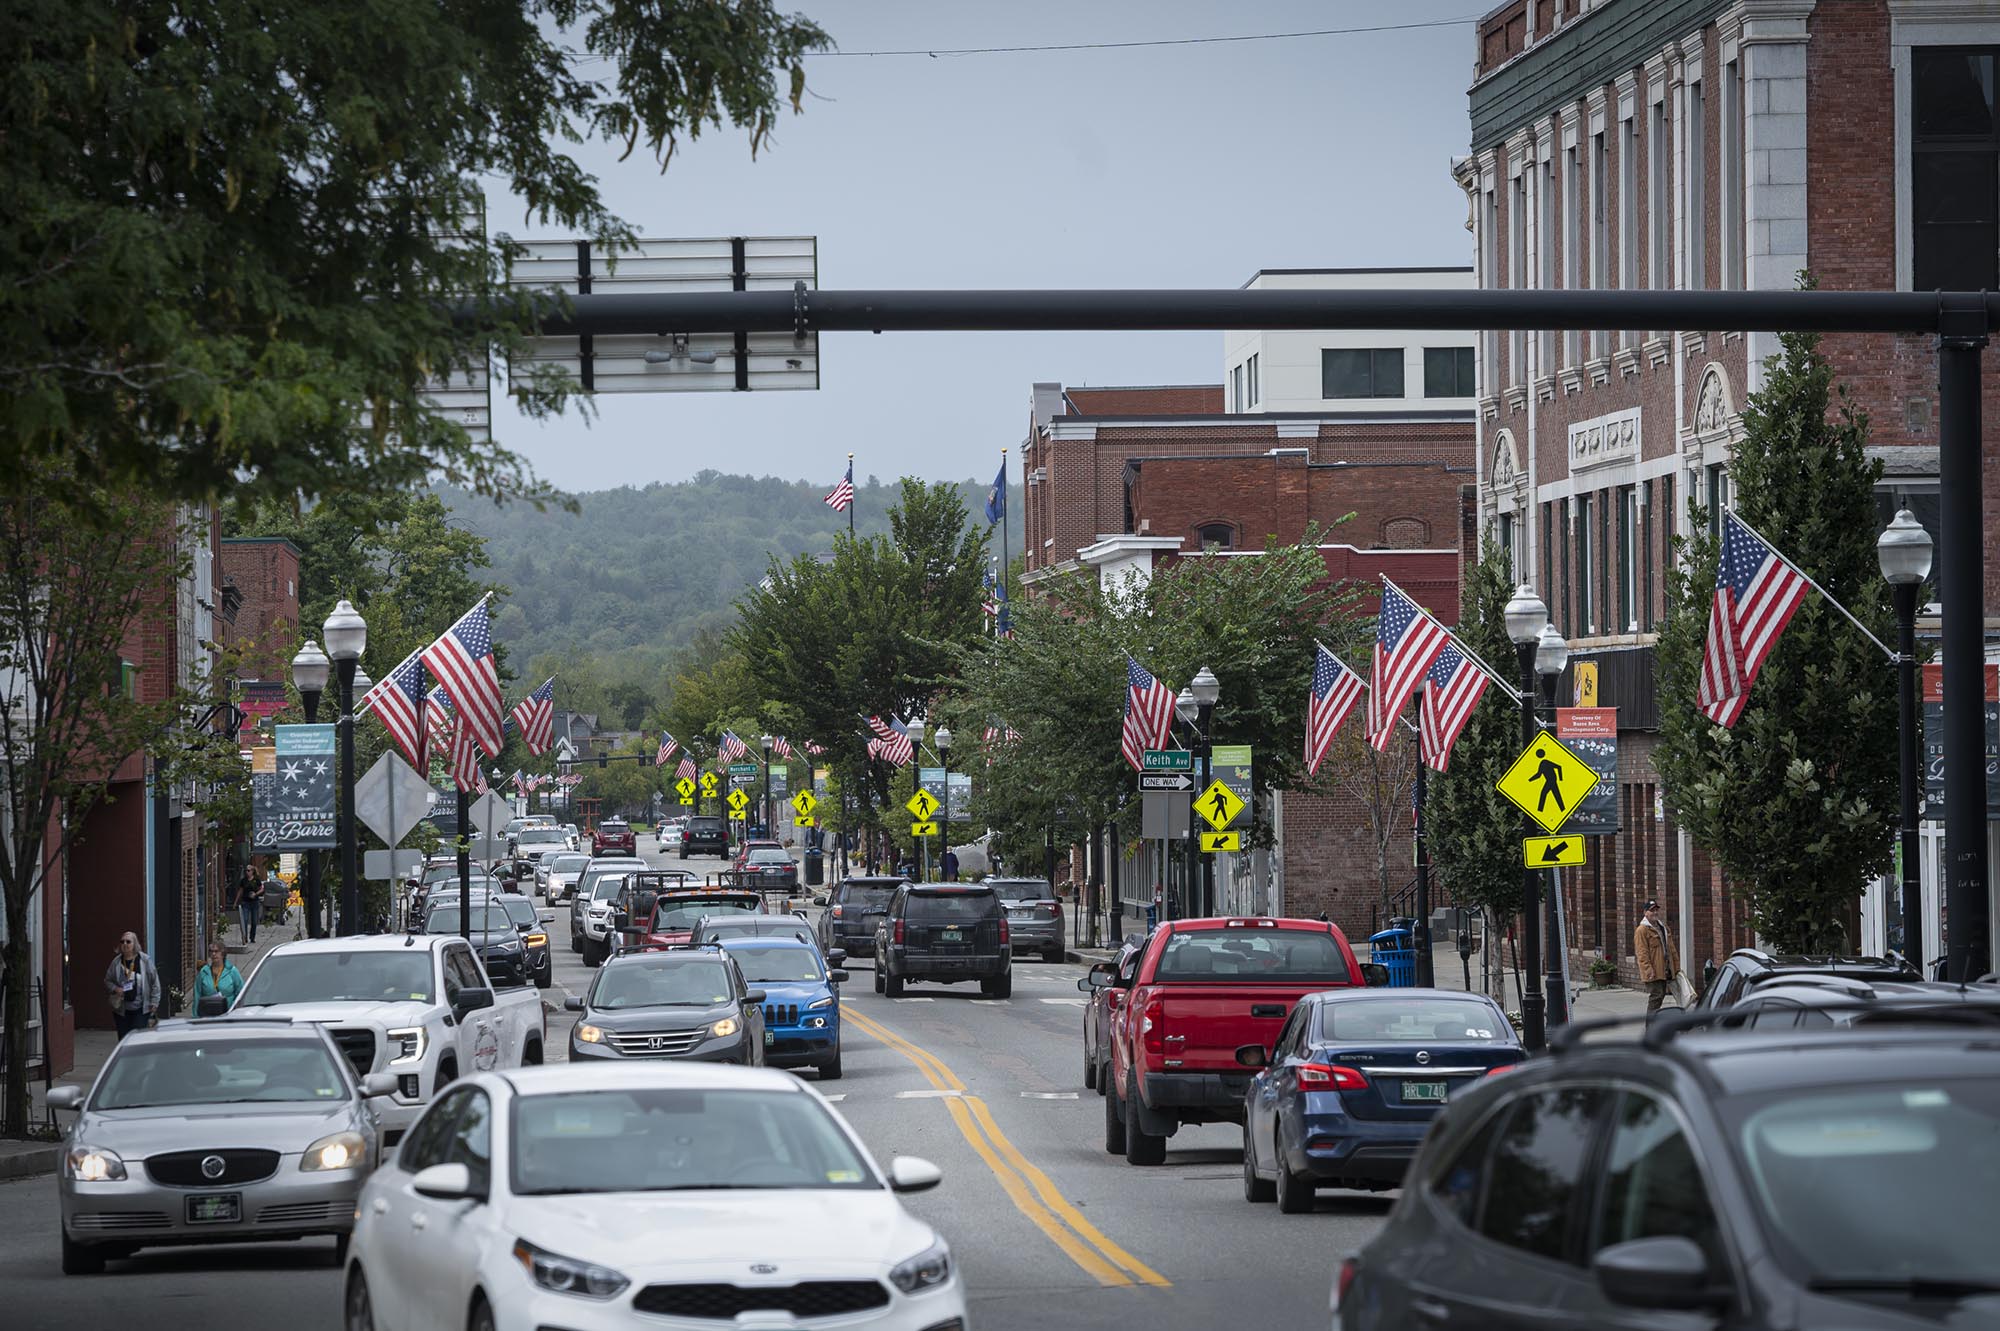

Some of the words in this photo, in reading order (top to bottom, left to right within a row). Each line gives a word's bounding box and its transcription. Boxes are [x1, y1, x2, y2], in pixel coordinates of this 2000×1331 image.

[1146, 755, 1171, 766] Keith
[1176, 758, 1188, 766] Ave
[1145, 778, 1162, 787] ONE
[1162, 778, 1178, 787] WAY
[1589, 784, 1615, 796] rre
[280, 812, 334, 820] DOWNTOWN
[278, 821, 335, 841] Barre
[1465, 1028, 1493, 1038] 43
[1404, 1084, 1421, 1097] HRL
[1427, 1084, 1446, 1098] 740
